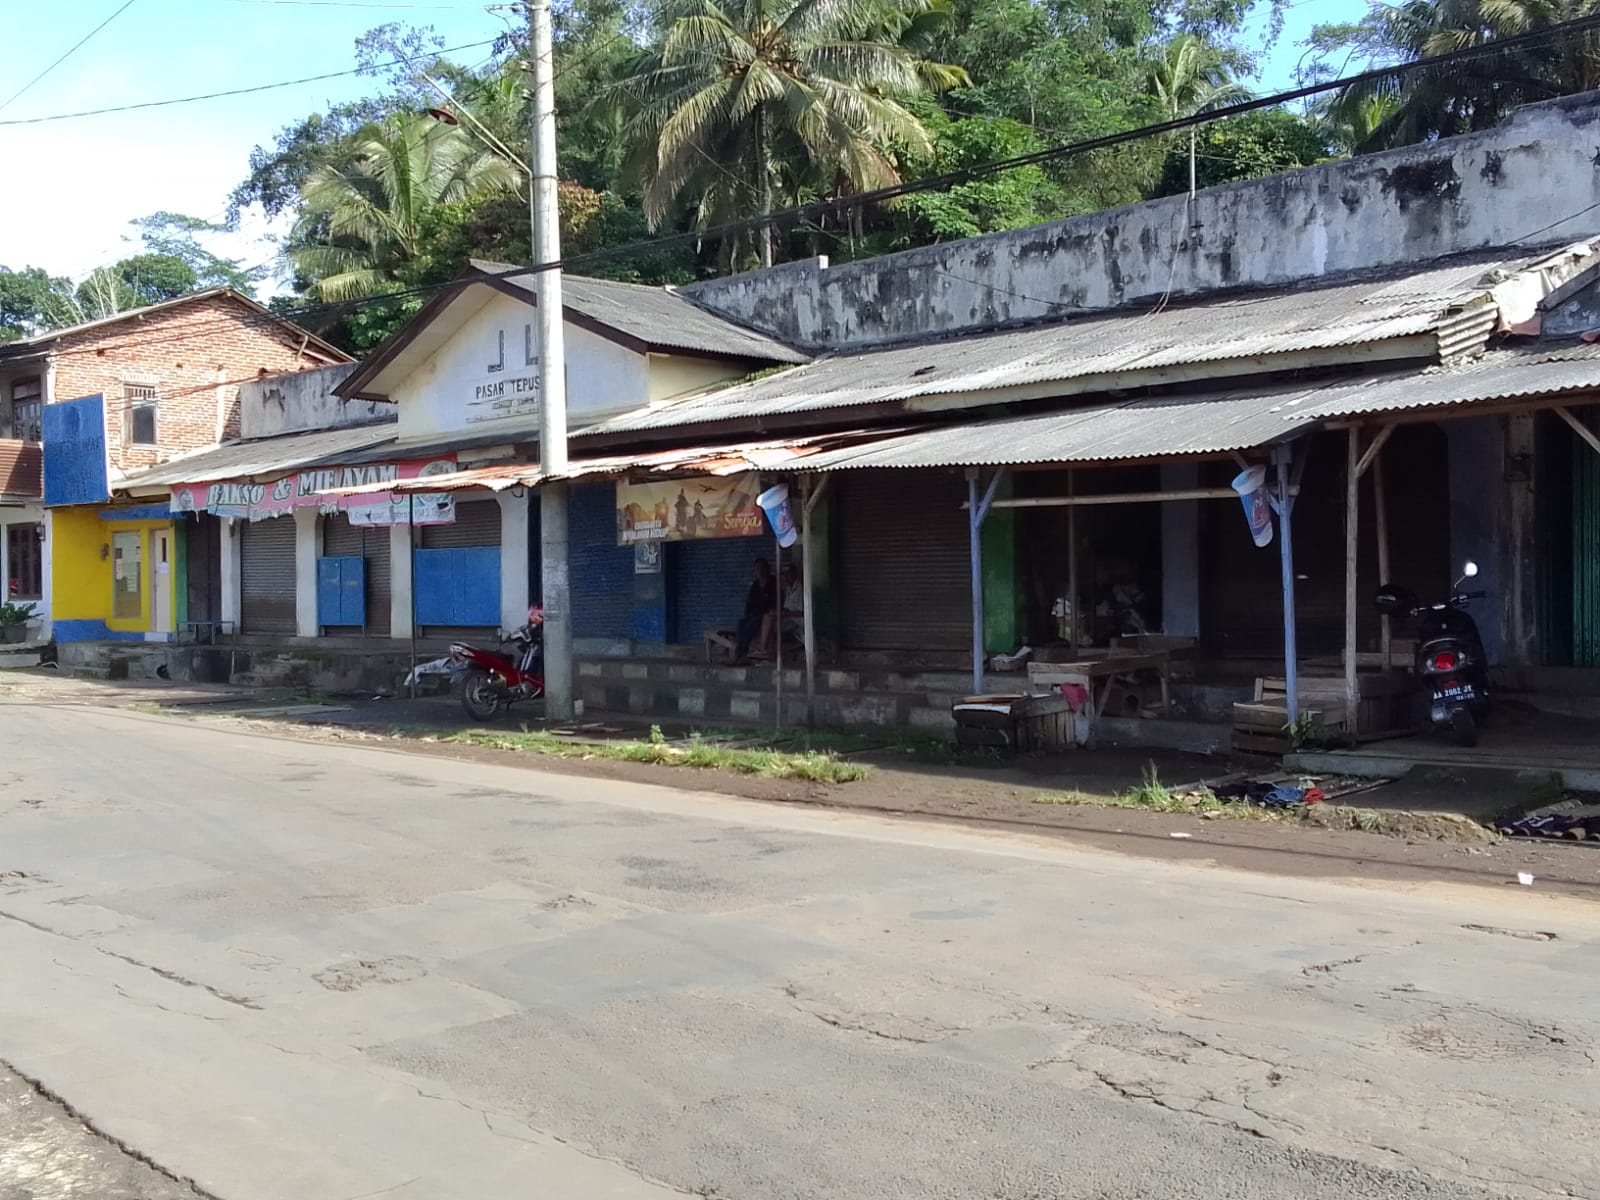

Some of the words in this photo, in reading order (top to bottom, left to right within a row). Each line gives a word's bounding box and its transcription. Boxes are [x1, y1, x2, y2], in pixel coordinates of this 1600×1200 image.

[475, 381, 505, 400] PASAR
[207, 482, 265, 507] BAKSO
[273, 478, 293, 501] &
[341, 463, 398, 488] AYAM
